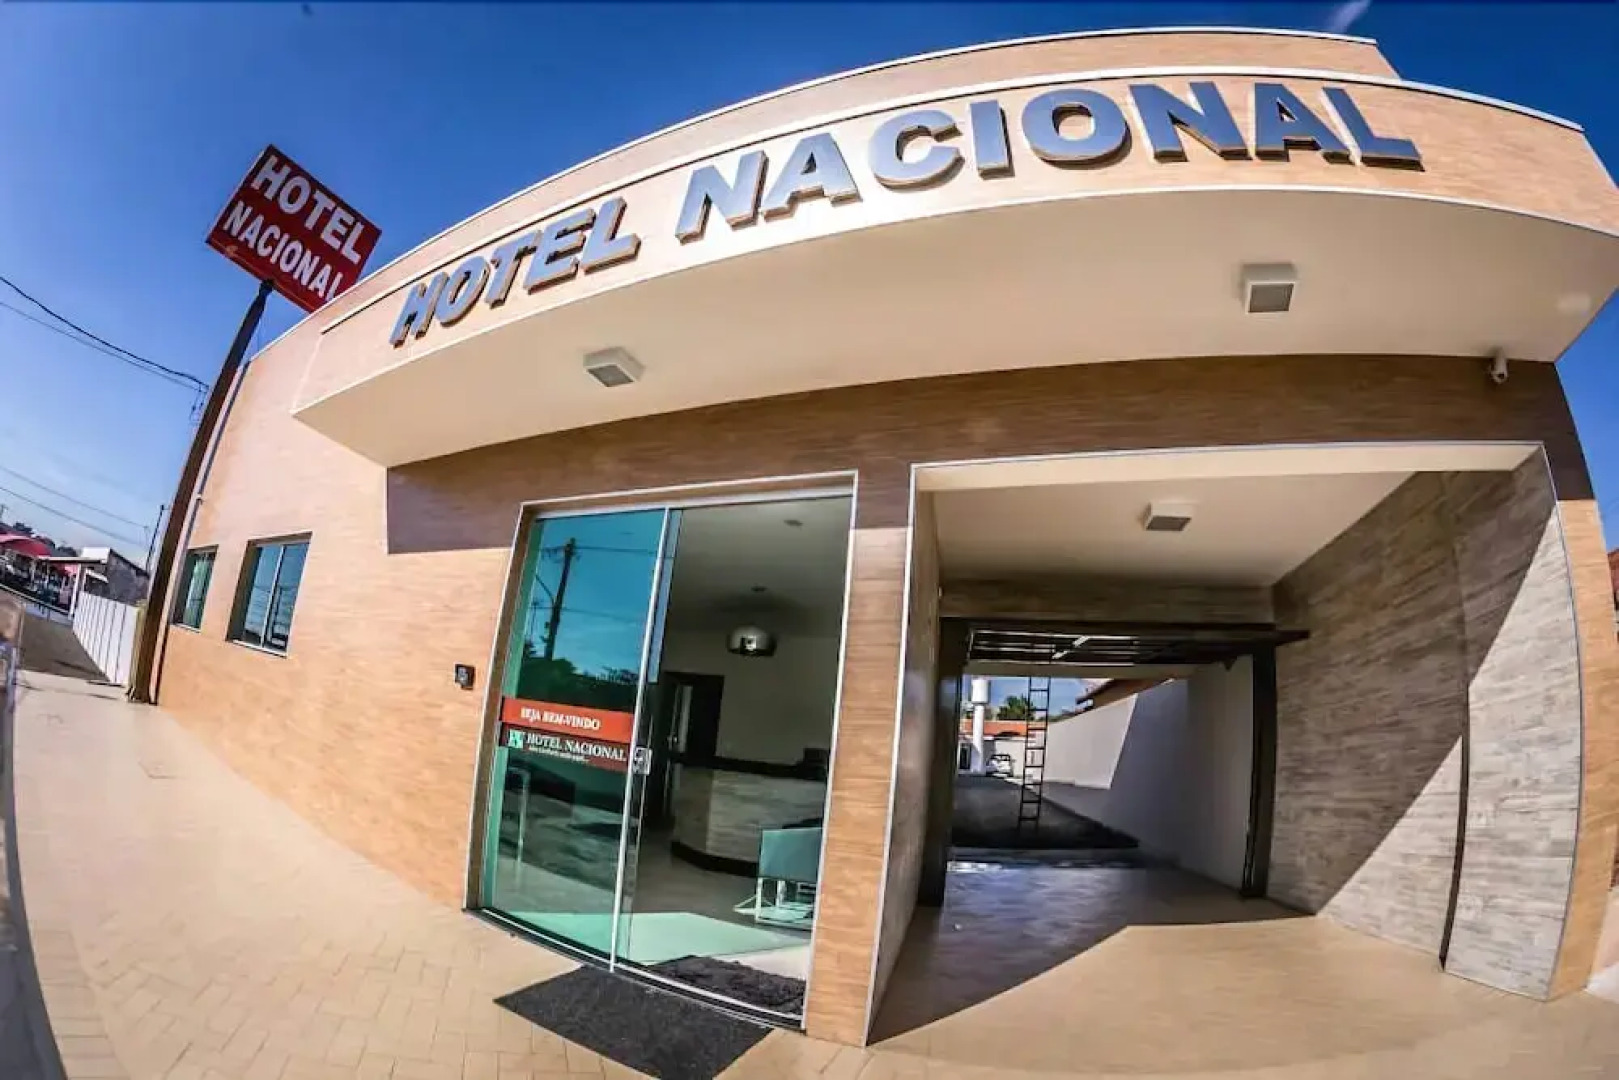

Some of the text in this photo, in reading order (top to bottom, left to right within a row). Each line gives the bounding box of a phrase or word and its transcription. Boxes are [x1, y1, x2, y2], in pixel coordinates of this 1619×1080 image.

[251, 155, 365, 264] HOTEL
[389, 81, 1424, 348] HOTEL NACIONAL
[527, 732, 562, 750] HOTEL
[565, 739, 627, 762] NACIONAL
[542, 710, 600, 731] BEM-VINDO
